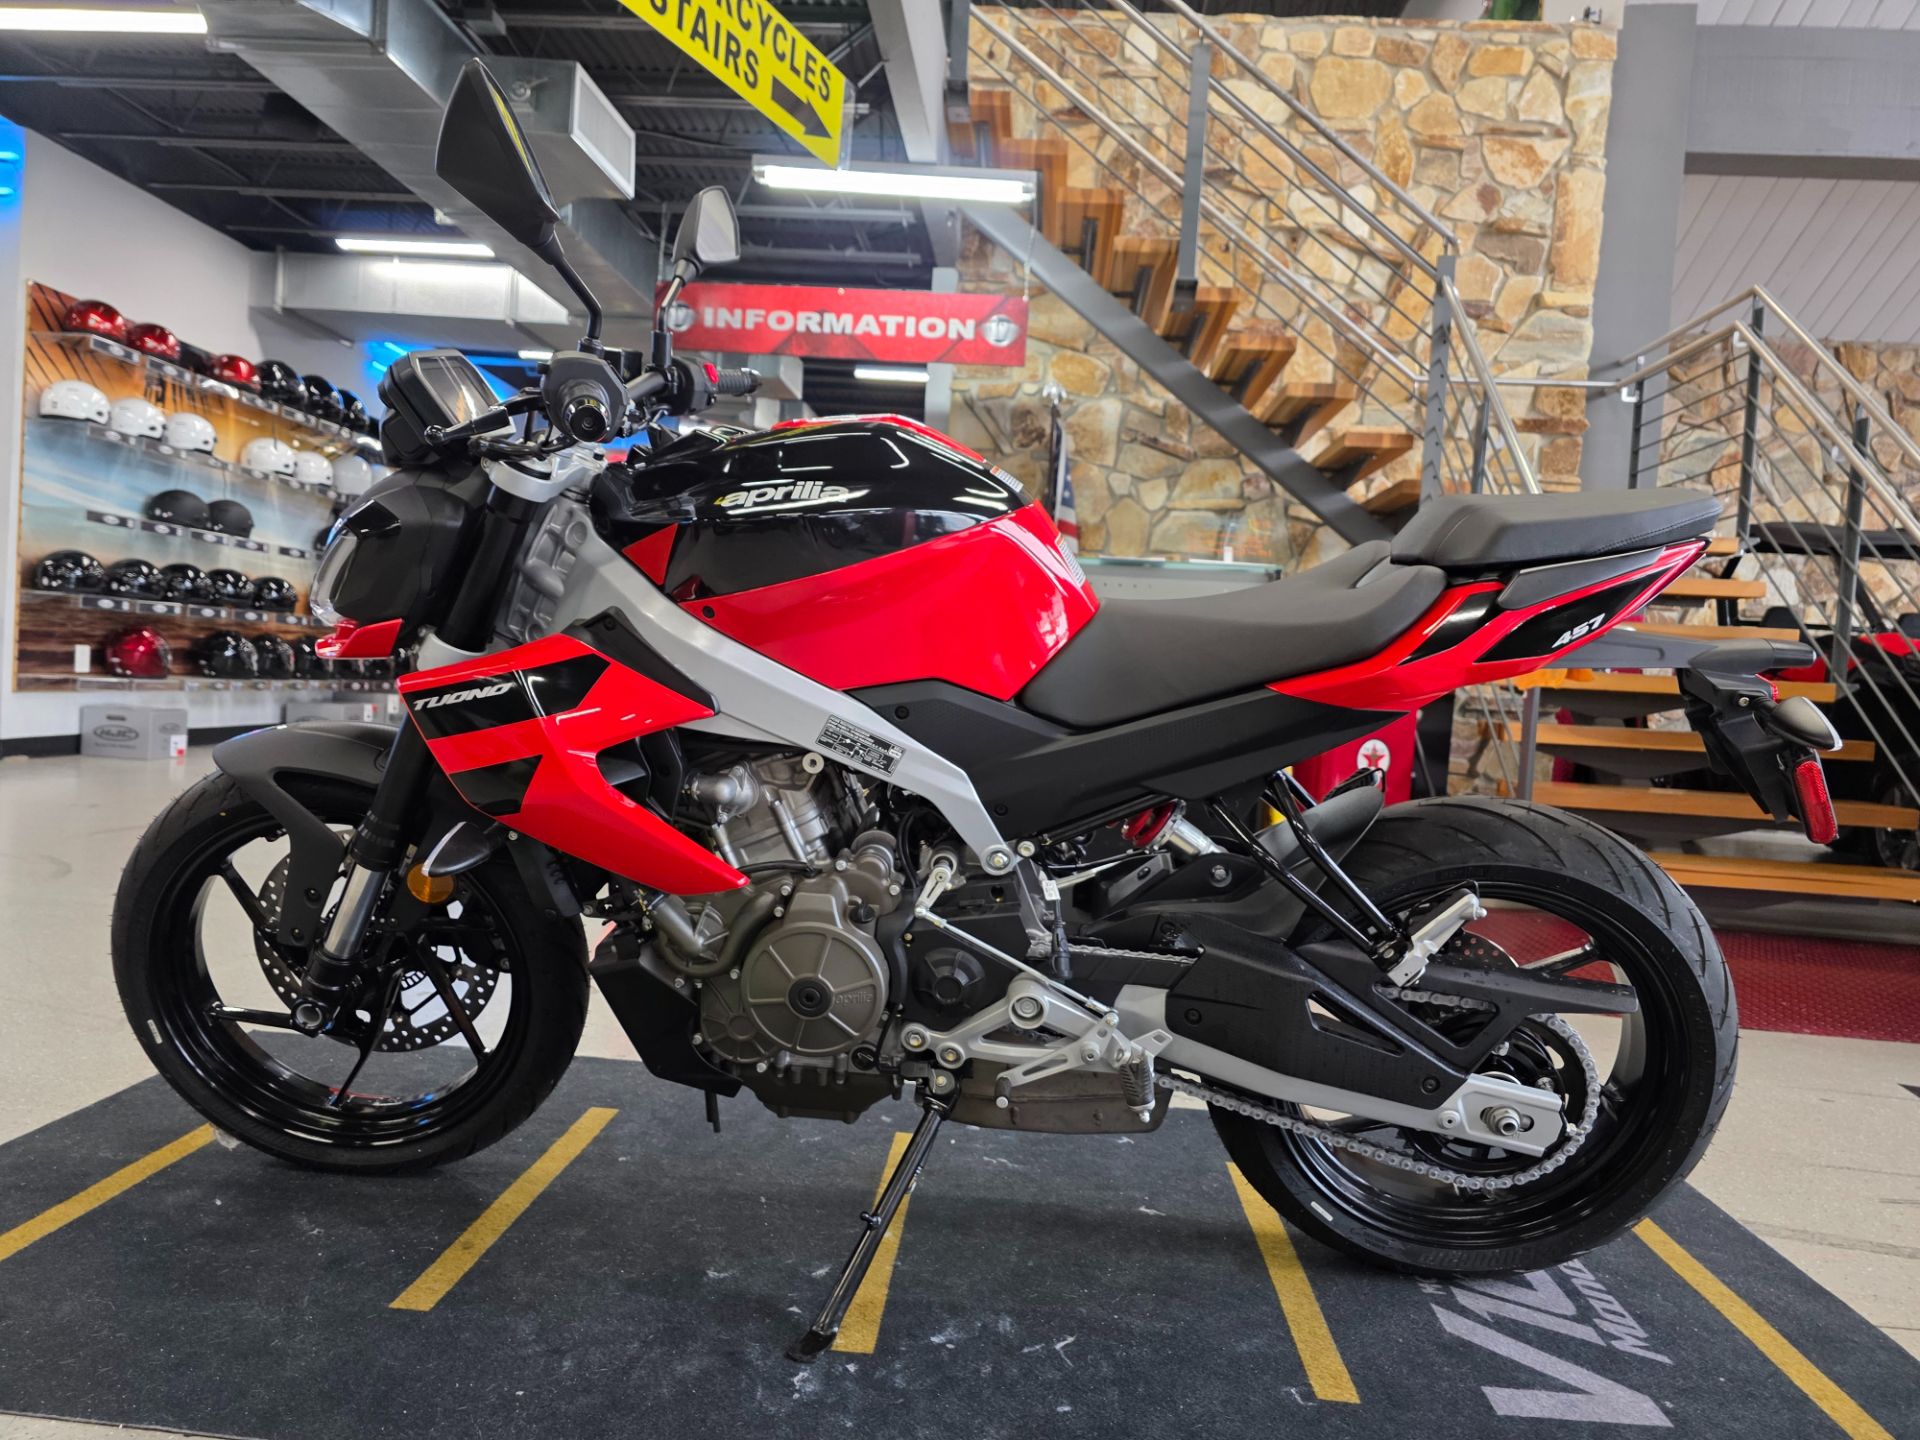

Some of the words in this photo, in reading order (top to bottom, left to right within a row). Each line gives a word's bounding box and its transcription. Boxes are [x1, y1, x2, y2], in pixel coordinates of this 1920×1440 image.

[703, 307, 975, 341] INFORMATION
[720, 480, 849, 508] aprilia
[1551, 612, 1606, 649] 457
[413, 682, 515, 711] TUONO
